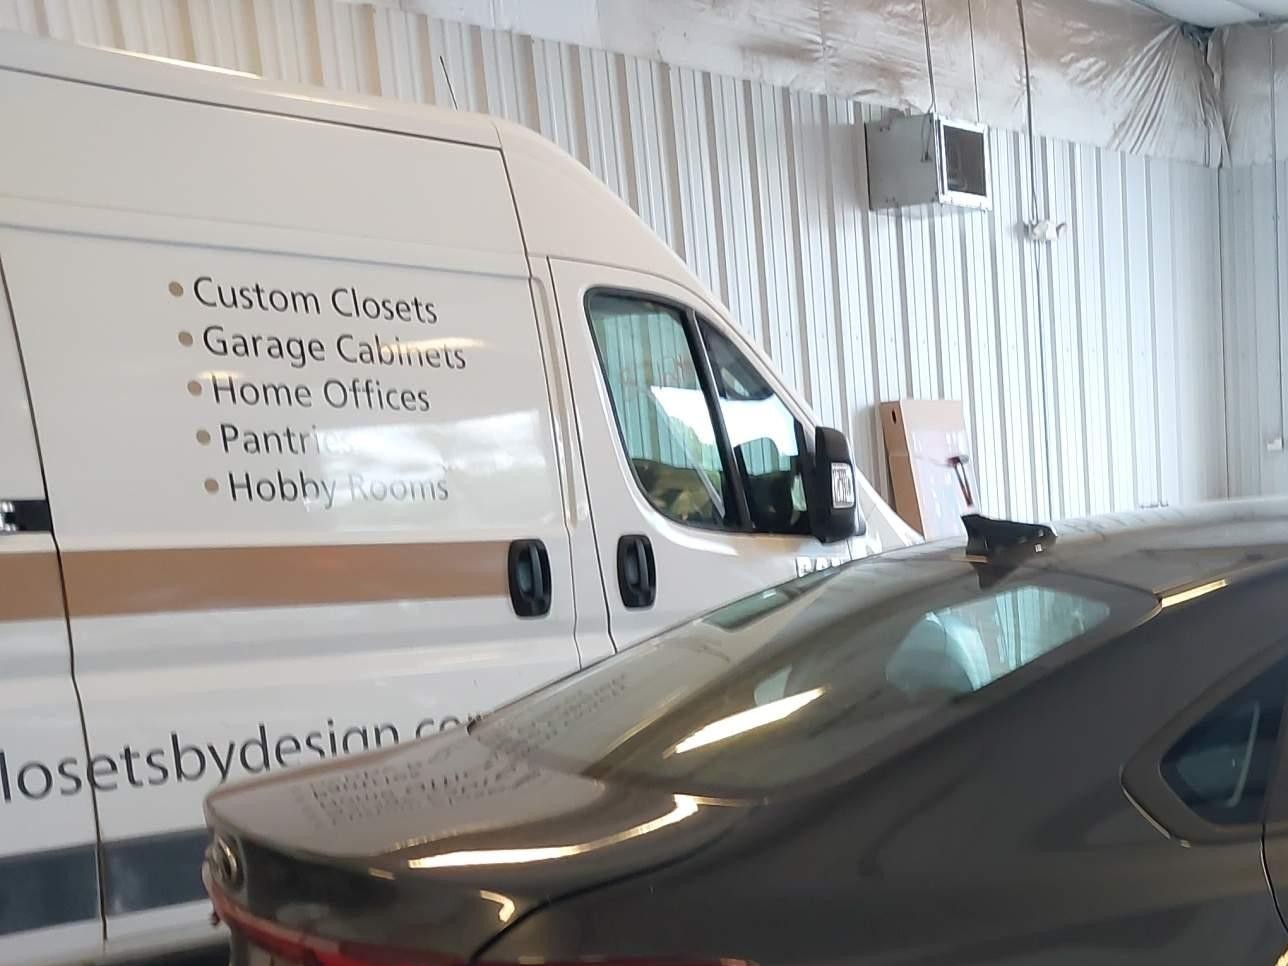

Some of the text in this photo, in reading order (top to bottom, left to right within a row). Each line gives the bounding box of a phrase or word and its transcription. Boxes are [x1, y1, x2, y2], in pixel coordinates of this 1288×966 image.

[193, 276, 438, 324] Custom Closets
[202, 325, 467, 370] Garage Cabinets
[211, 374, 431, 412] Home Offices
[220, 423, 353, 455] Pantries
[228, 470, 449, 510] Hobby Rooms
